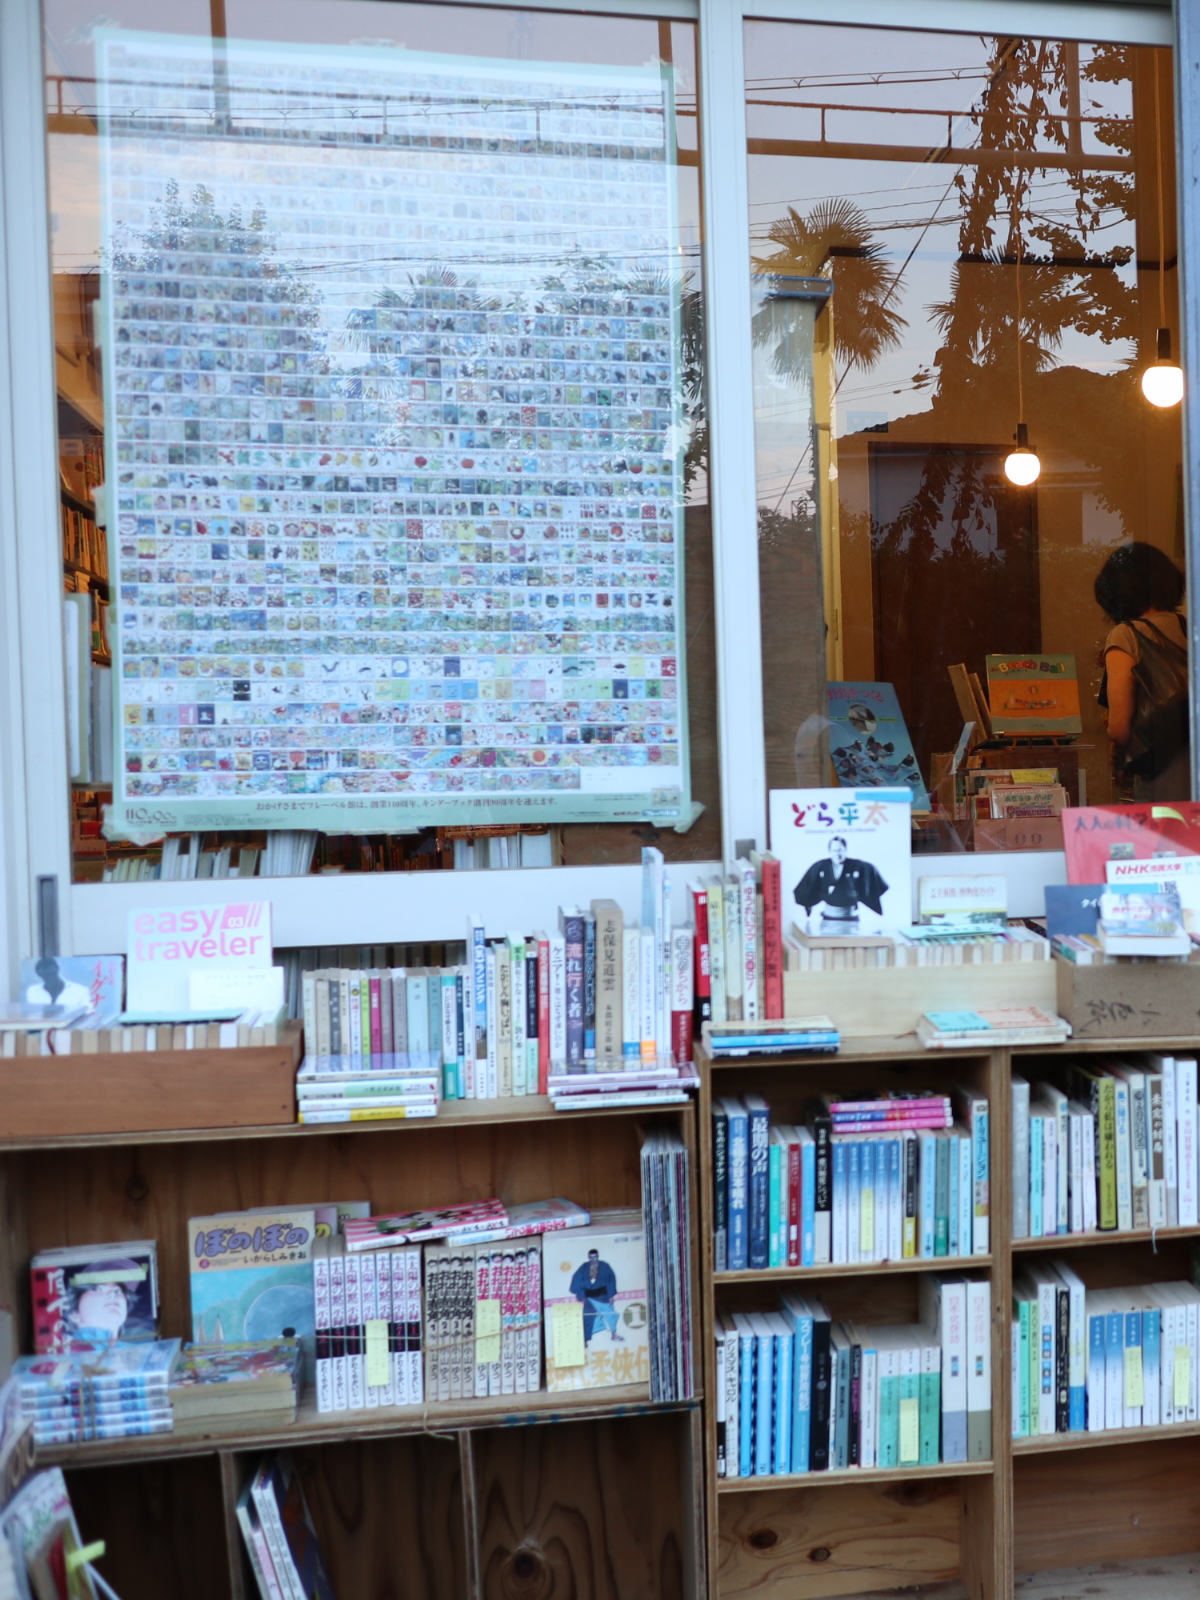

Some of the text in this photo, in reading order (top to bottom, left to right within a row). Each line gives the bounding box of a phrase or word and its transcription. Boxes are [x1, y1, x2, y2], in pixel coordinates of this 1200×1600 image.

[791, 802, 889, 827] どら平太
[1115, 864, 1150, 876] NHK
[134, 909, 243, 938] easy 03
[135, 934, 264, 962] traveler
[194, 1222, 310, 1258] ぼのぼの
